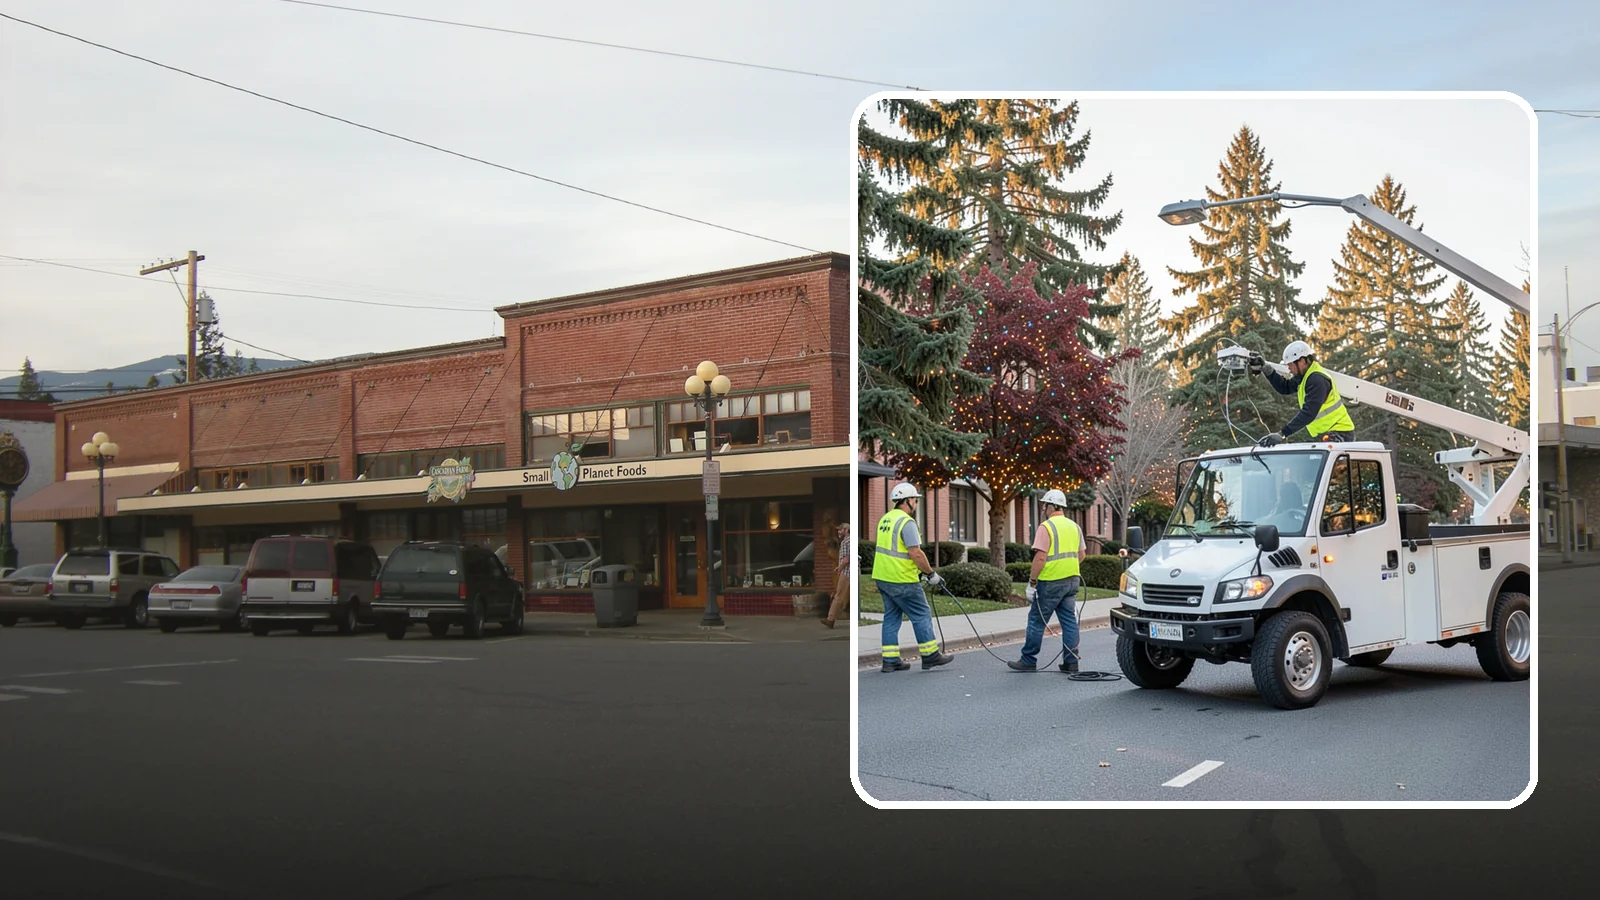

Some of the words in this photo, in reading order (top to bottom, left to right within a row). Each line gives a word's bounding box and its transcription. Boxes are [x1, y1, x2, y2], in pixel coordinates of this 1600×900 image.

[522, 471, 549, 483] Small
[582, 467, 614, 479] Planet
[616, 464, 647, 477] Foods
